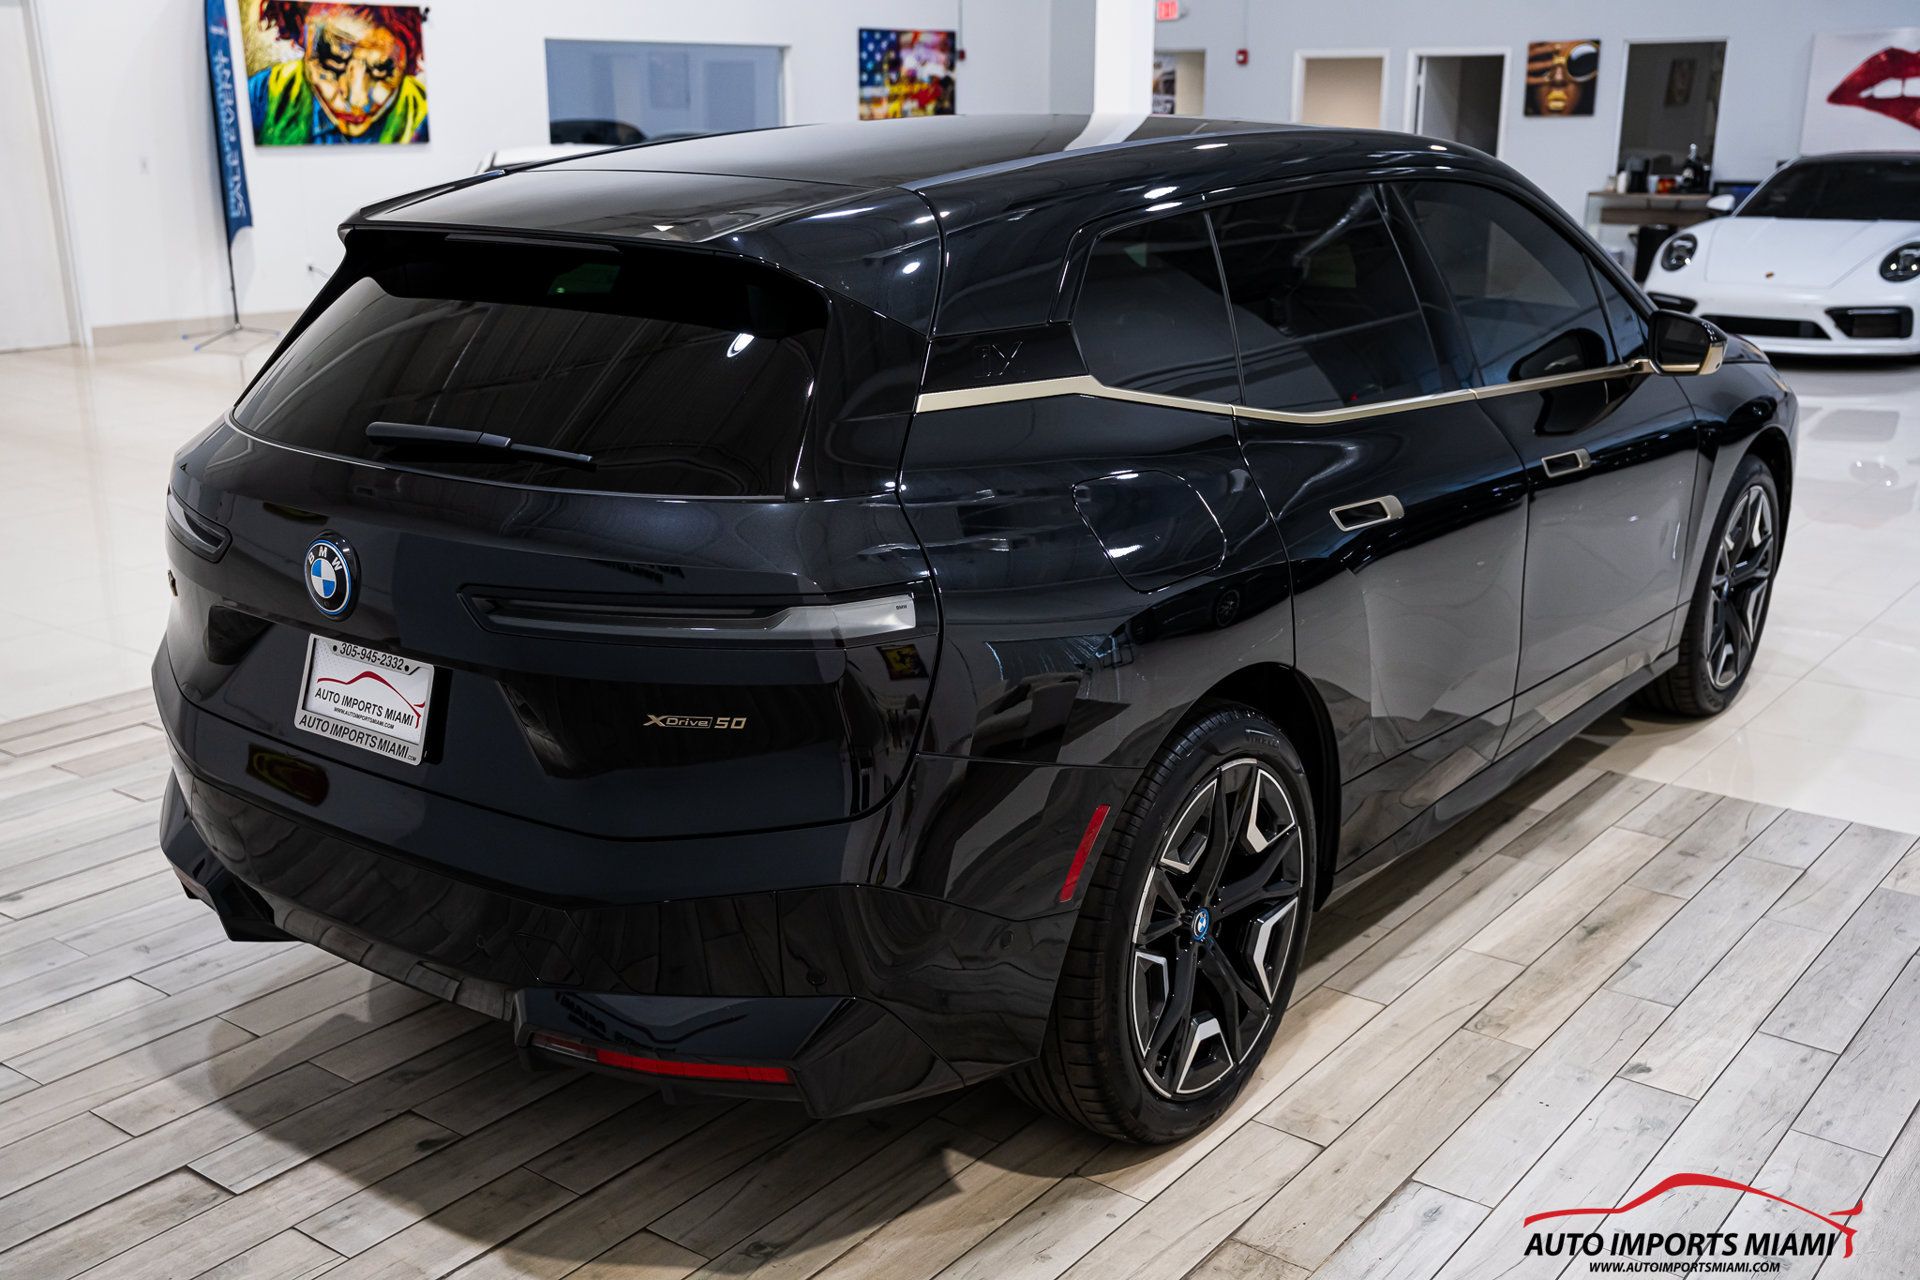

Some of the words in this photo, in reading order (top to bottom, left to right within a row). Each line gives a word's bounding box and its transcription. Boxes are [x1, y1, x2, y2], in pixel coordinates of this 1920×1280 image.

[308, 545, 342, 571] BMW
[339, 642, 404, 671] 305-945-2332
[314, 687, 341, 704] AUTO
[341, 694, 384, 717] IMPORTS
[384, 707, 414, 726] MIAMI
[333, 706, 395, 730] WWW.AUTOIMPORTSMIAMI.COM
[298, 713, 329, 733] AUTO
[329, 722, 378, 748] IMPORTS
[714, 717, 748, 729] 50
